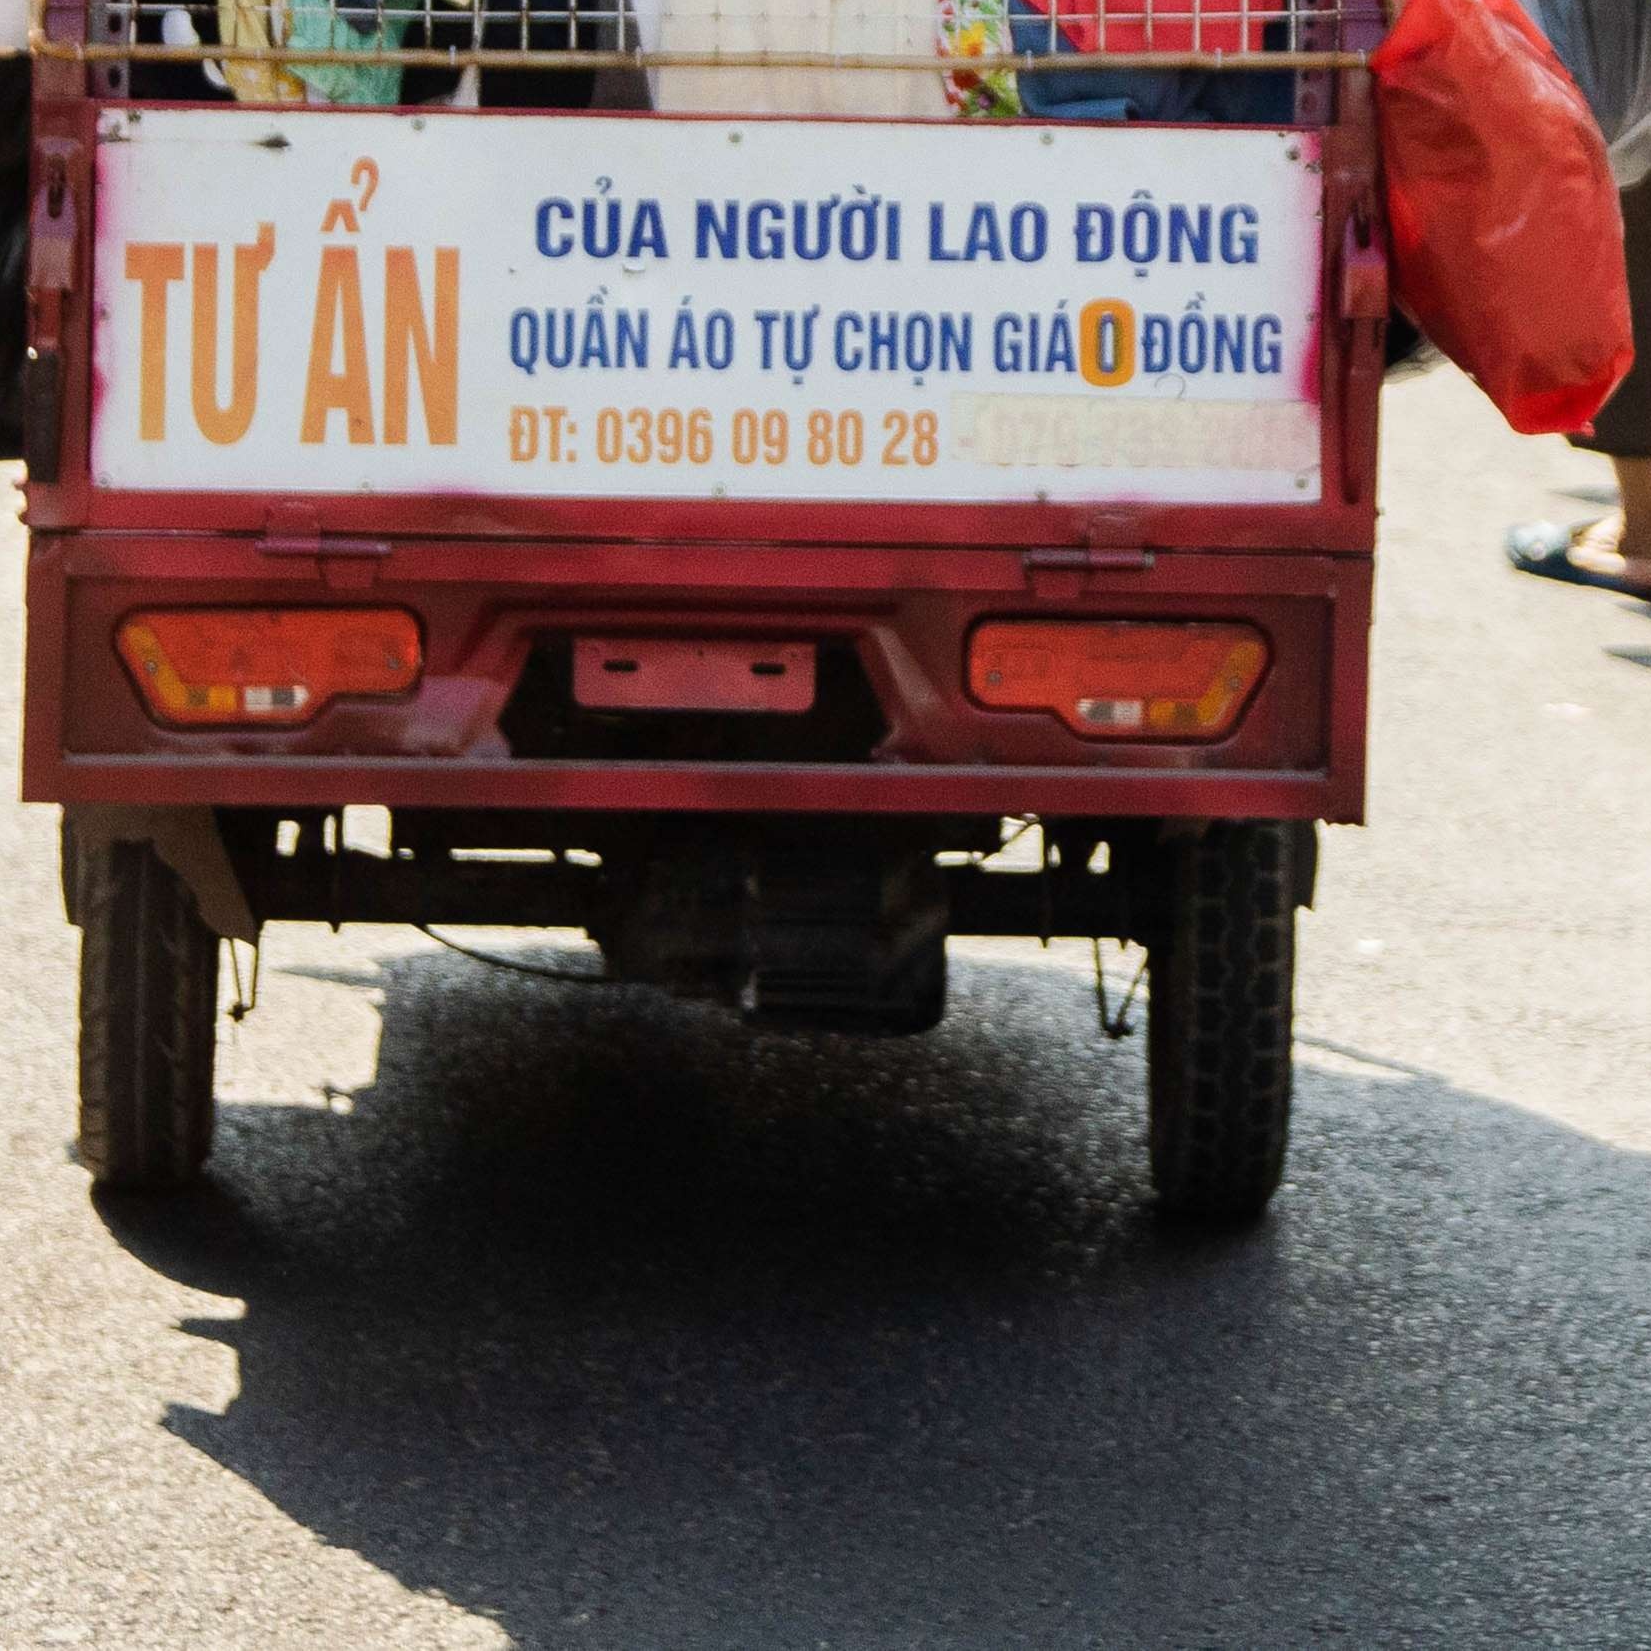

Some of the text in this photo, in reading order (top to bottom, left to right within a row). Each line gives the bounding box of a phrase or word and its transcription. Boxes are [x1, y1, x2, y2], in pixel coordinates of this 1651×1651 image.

[535, 175, 1259, 278] CỦA NGƯỜI LAO ĐỘNG
[124, 158, 460, 446] TƯ ẨN
[509, 284, 649, 376] QUẦN
[669, 295, 735, 371] ÁO
[755, 308, 819, 387] TỰ
[833, 312, 973, 387] CHỌN
[993, 299, 1077, 373] GIÁ
[1140, 291, 1282, 374] ĐỒNG
[508, 406, 577, 464] ĐT:
[597, 408, 714, 465] 0396
[732, 410, 789, 466] 09
[807, 411, 864, 467] 80
[881, 411, 939, 468] 28
